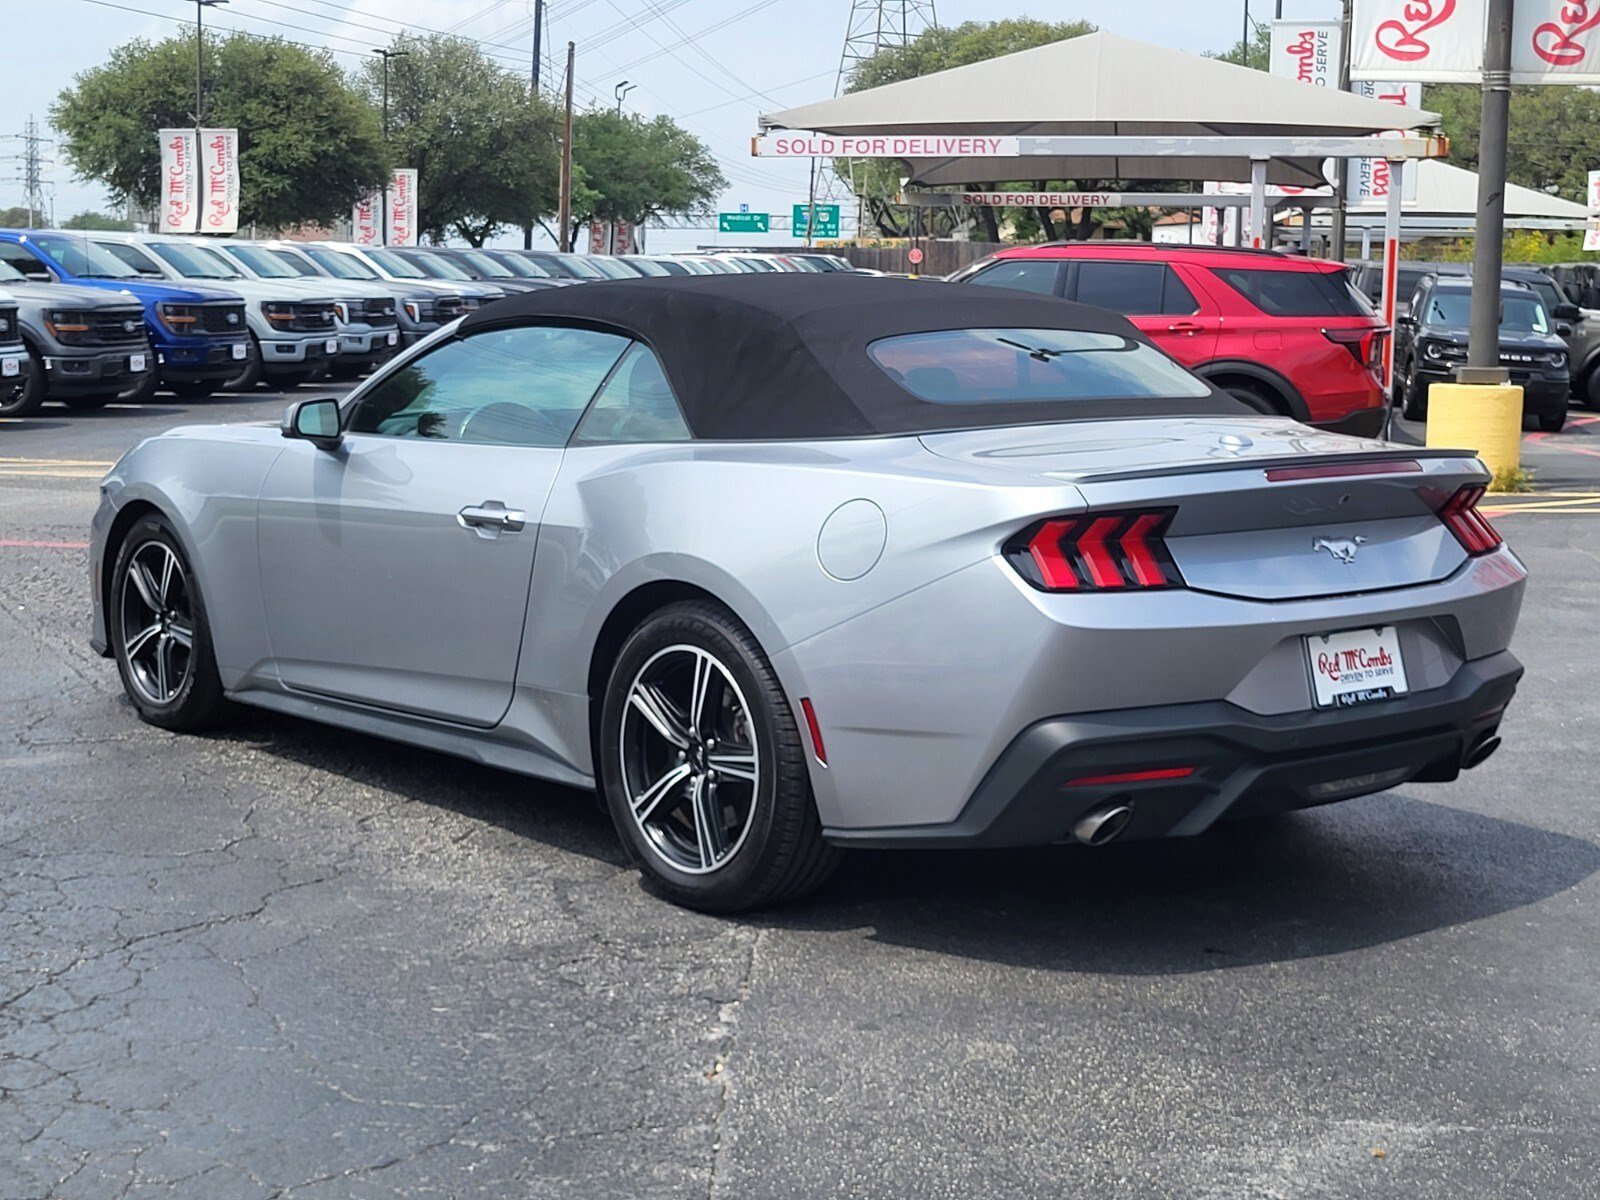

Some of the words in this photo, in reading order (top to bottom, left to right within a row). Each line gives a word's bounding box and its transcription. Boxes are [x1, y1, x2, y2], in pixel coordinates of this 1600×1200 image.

[1376, 0, 1457, 61] Re
[1532, 0, 1600, 66] Re
[1316, 30, 1328, 73] SERVE
[1315, 77, 1326, 87] O
[776, 139, 834, 154] SOLD
[843, 139, 886, 154] FOR
[893, 138, 1002, 154] DELIVERY
[169, 136, 184, 198] McCombs
[210, 135, 225, 197] McCombs
[167, 200, 189, 227] Red
[208, 200, 230, 227] Red
[963, 194, 1001, 205] SOLD
[1005, 194, 1035, 205] FOR
[1039, 194, 1110, 205] DELIVERY
[1318, 651, 1341, 681] Red
[1340, 646, 1393, 671] McCombs
[1340, 671, 1363, 682] DRIVEN
[1364, 669, 1374, 678] TO
[1375, 667, 1394, 677] SERVE
